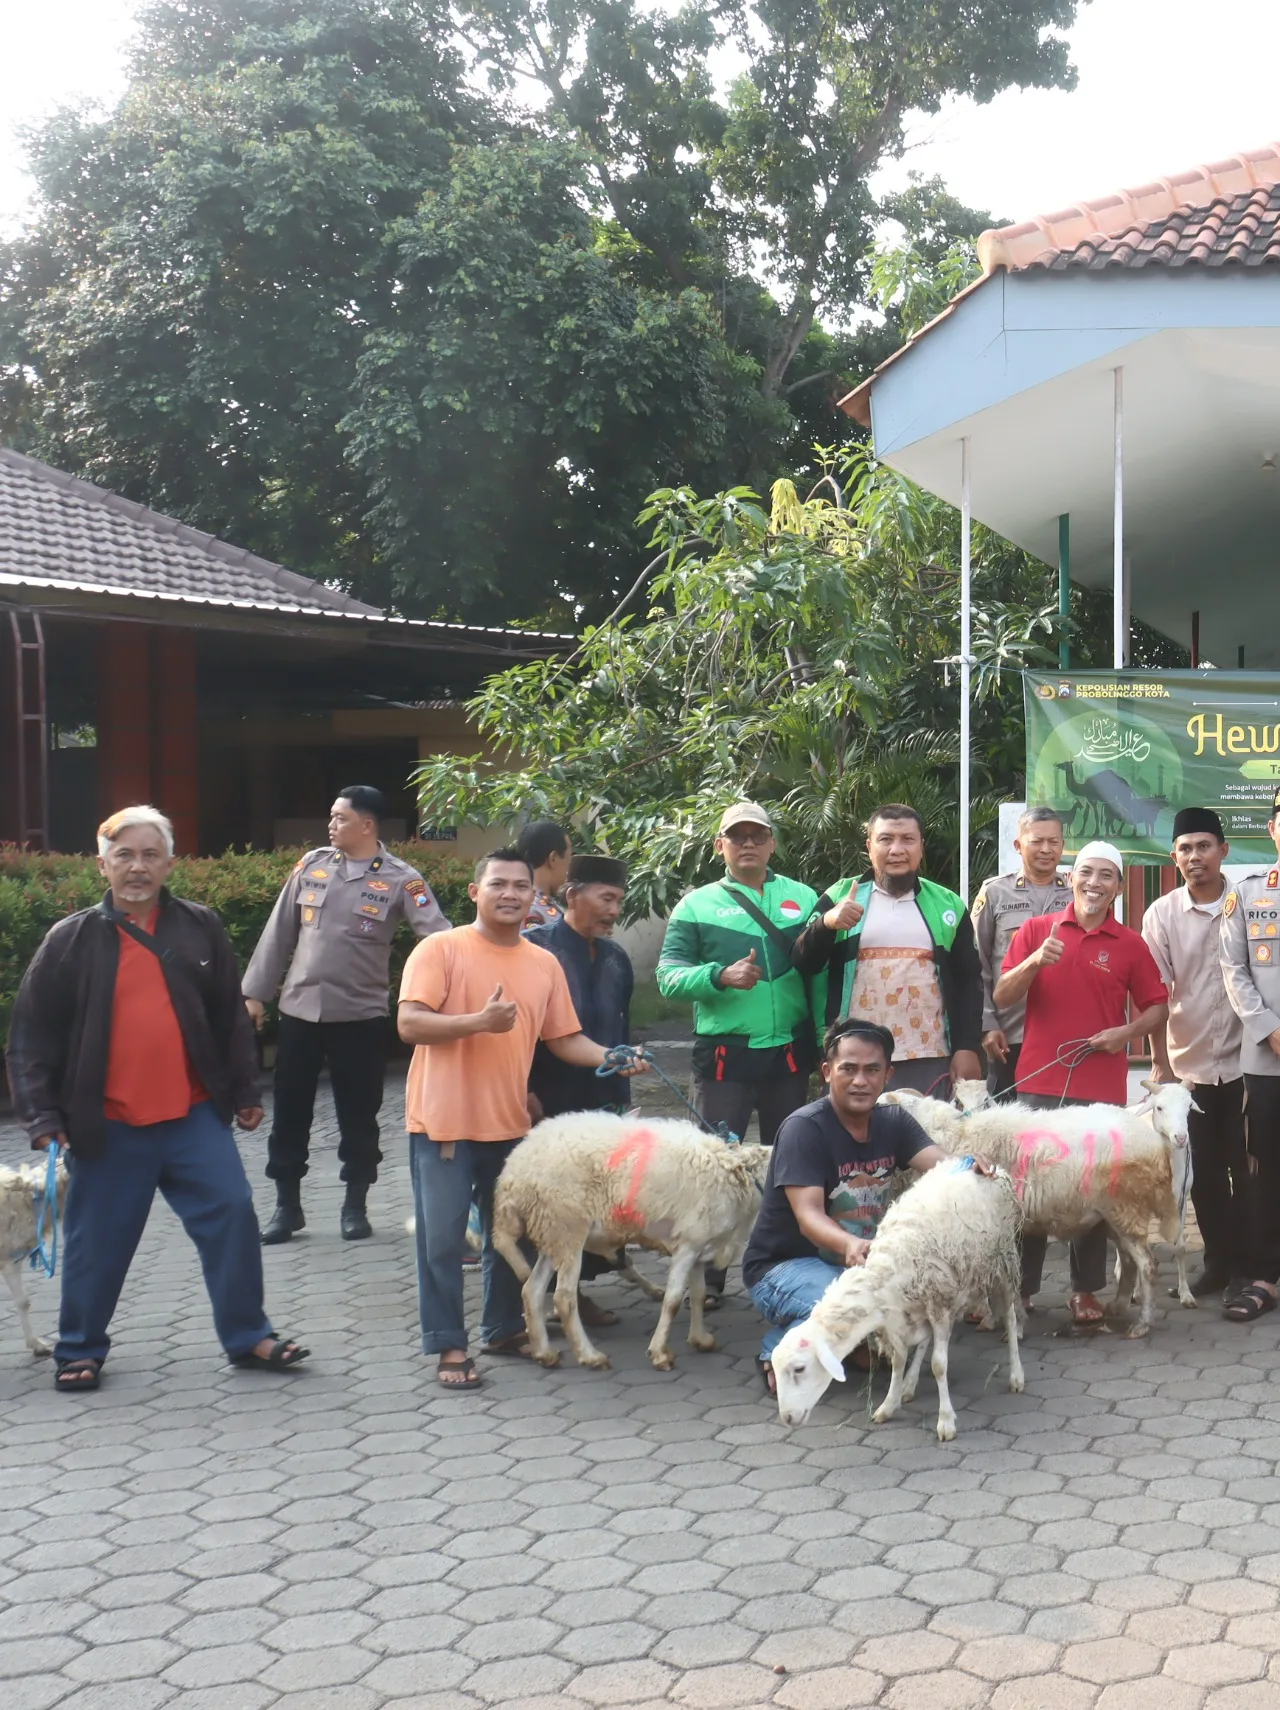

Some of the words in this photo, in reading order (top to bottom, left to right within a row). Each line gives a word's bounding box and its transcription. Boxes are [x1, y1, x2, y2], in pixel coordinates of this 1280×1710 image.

[1076, 684, 1130, 692] KEPOLISIAN
[1076, 690, 1142, 698] PROBOLINGGO
[1145, 690, 1170, 698] KOTA
[1225, 784, 1250, 792] Sebagai
[1252, 784, 1272, 792] wujud
[305, 881, 327, 890] WIWIN
[361, 891, 389, 903] POLRI
[1001, 902, 1030, 911] SUHARTA
[1248, 910, 1278, 919] RICO
